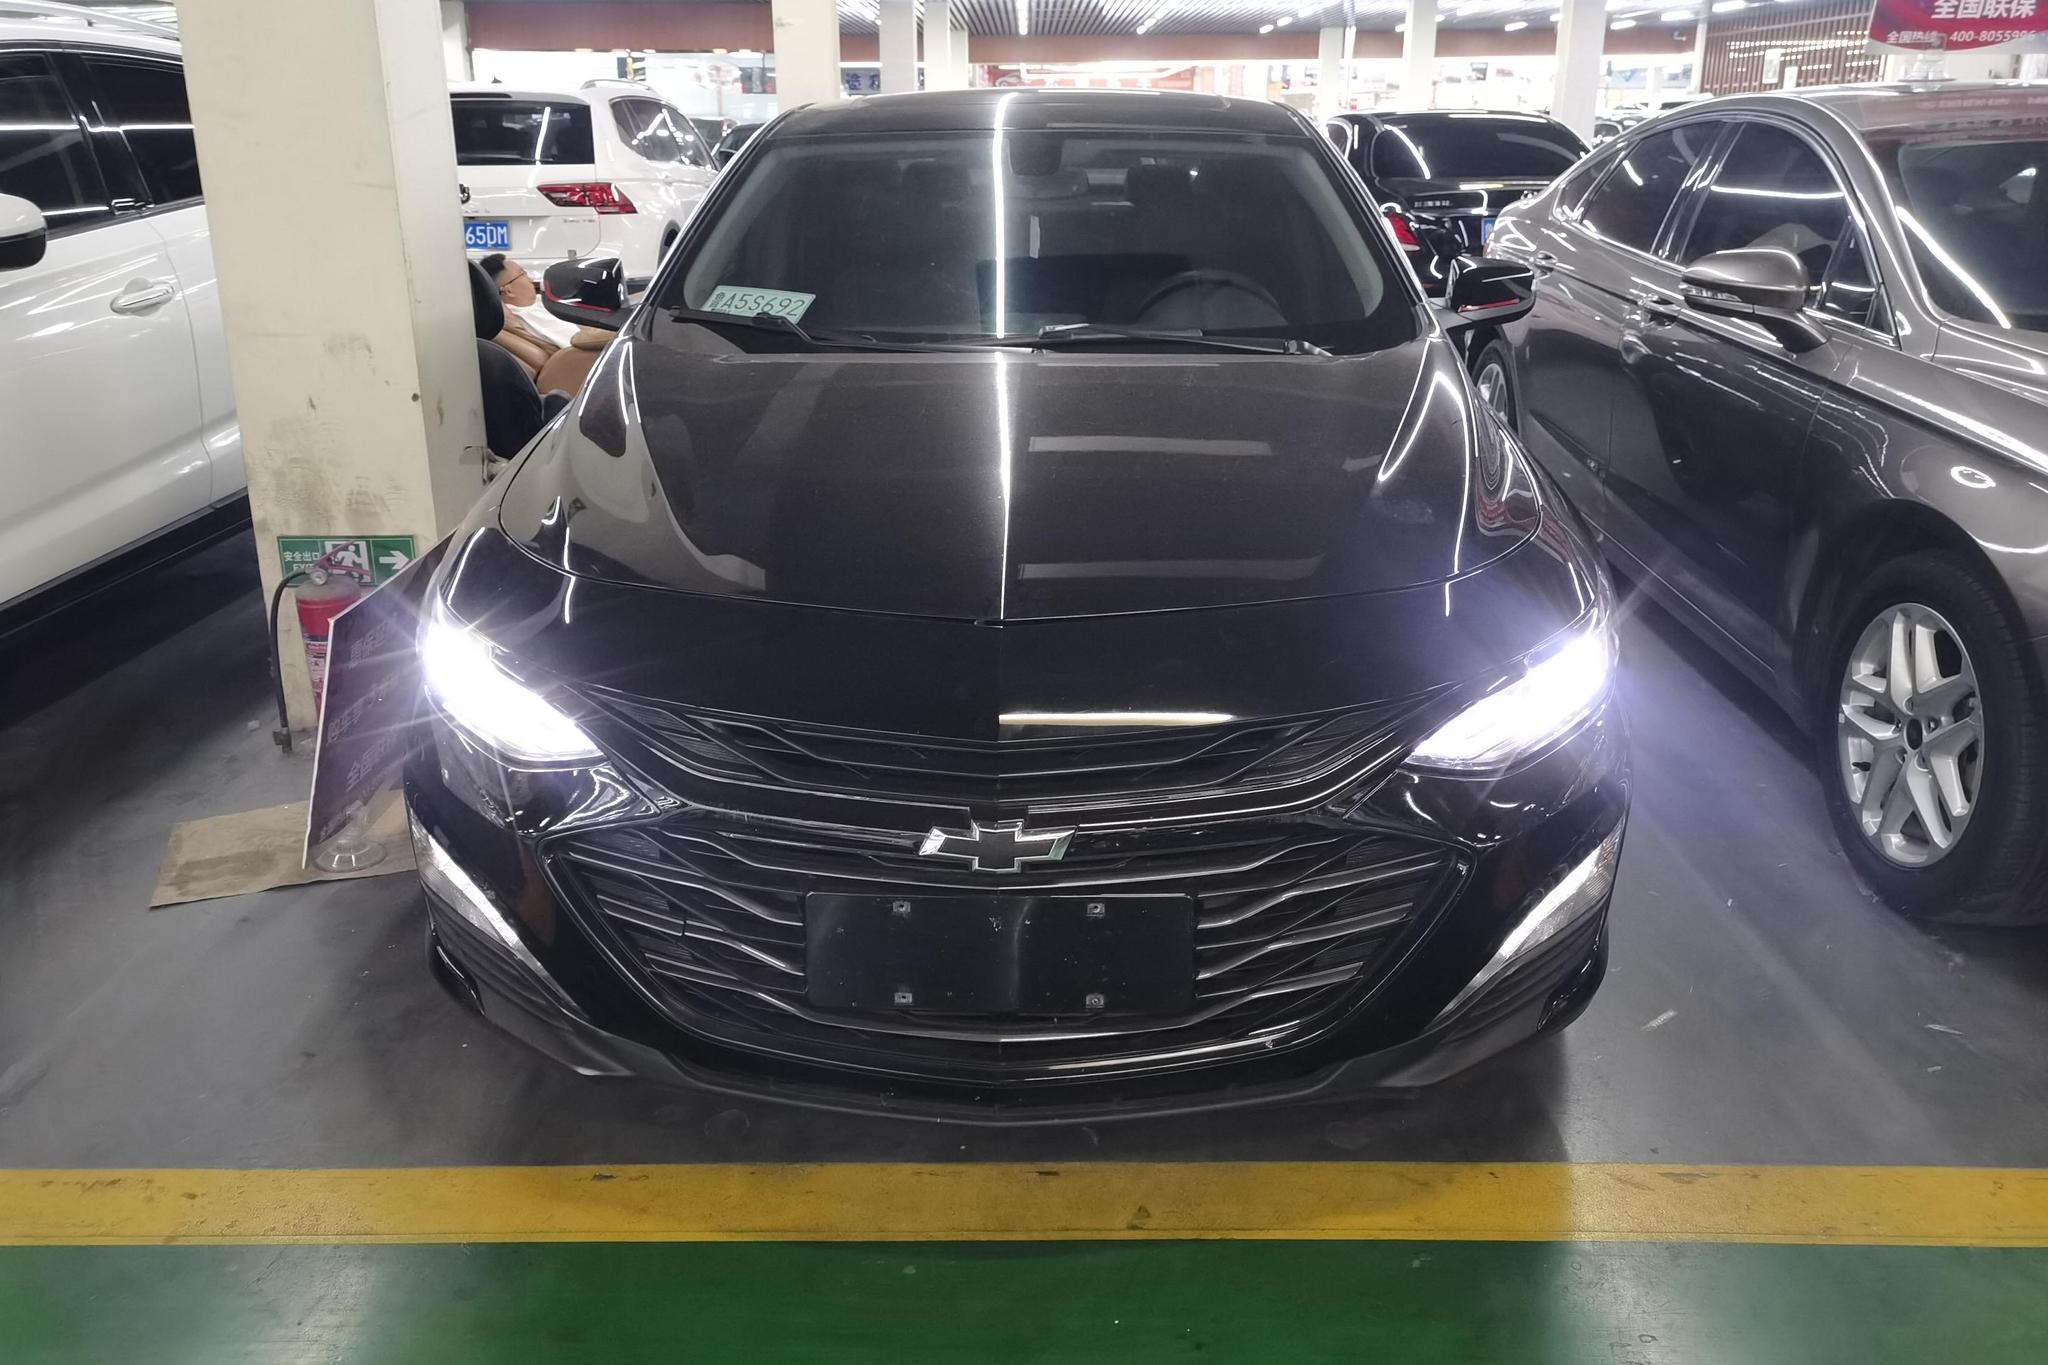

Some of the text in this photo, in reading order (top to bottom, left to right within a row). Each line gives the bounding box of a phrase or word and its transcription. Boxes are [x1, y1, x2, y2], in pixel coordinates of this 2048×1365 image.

[1931, 0, 2036, 19] 全国联保
[465, 226, 508, 245] 65DM
[283, 551, 320, 561] 安全出口
